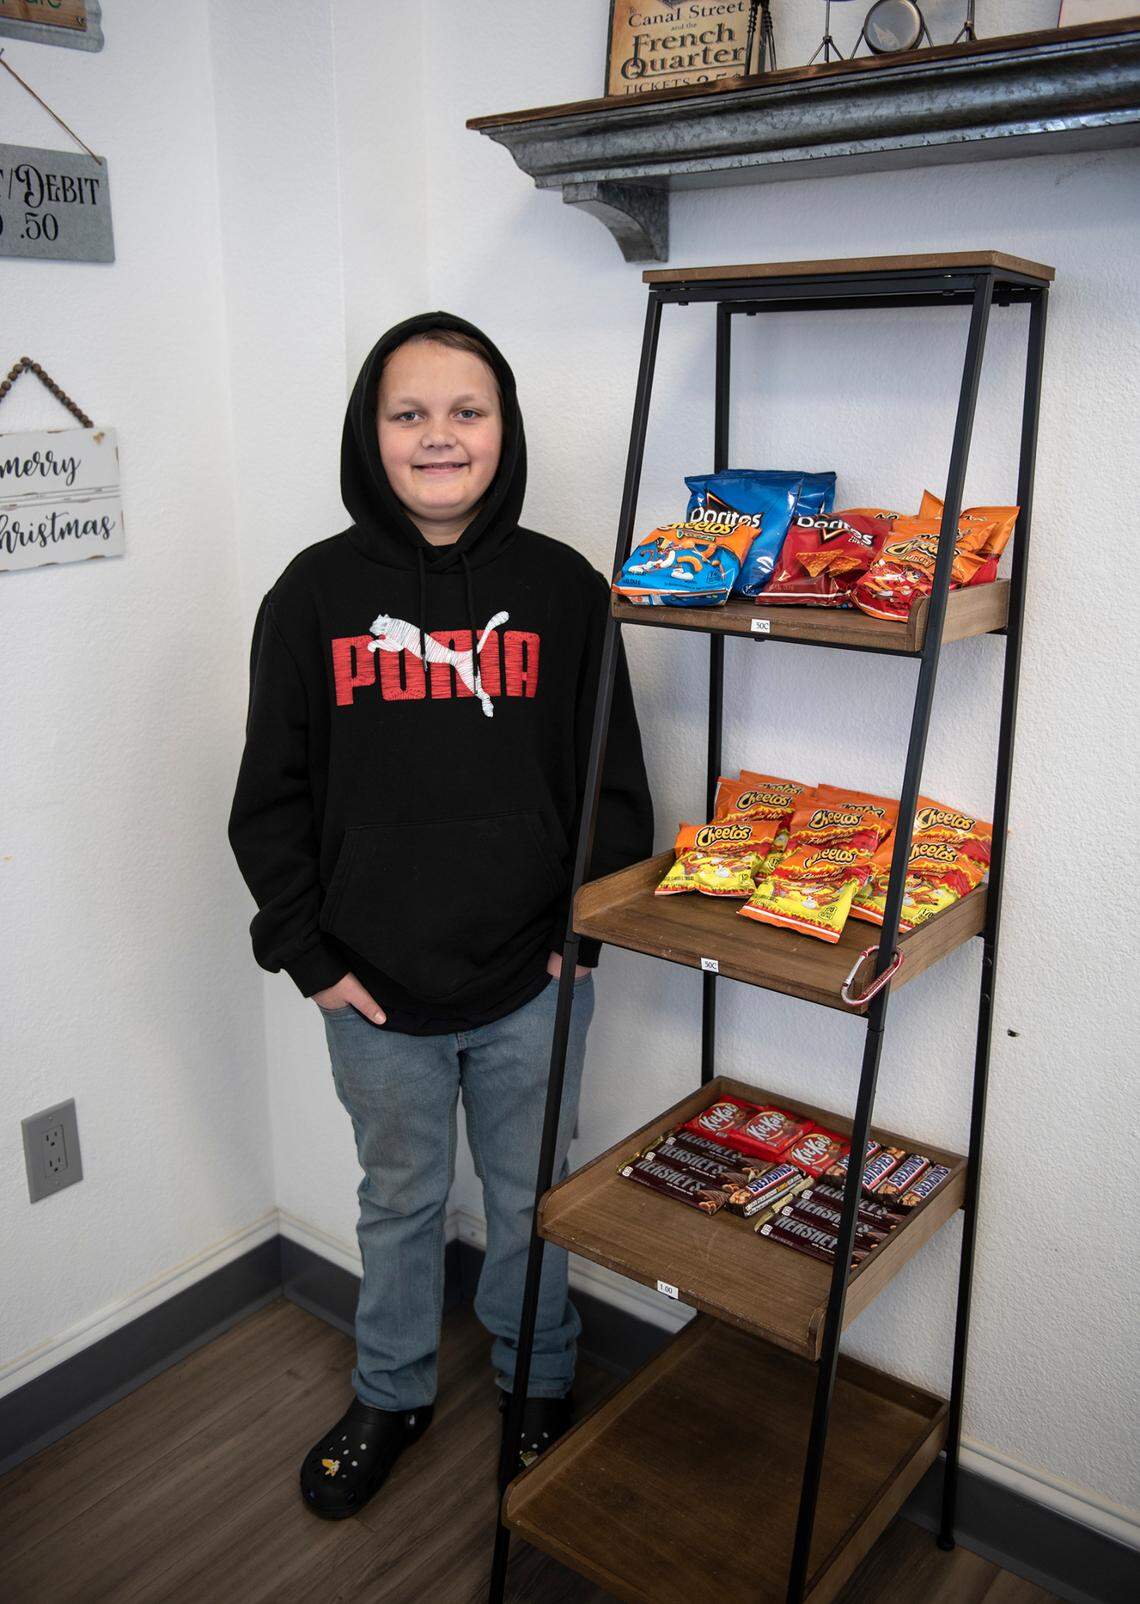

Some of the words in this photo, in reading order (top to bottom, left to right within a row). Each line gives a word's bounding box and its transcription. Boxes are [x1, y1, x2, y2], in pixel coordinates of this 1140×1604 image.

[628, 8, 681, 28] Canal
[689, 1, 745, 19] Street
[632, 22, 736, 52] French
[621, 46, 745, 80] Quarter
[21, 212, 59, 241] .50
[0, 450, 81, 486] merry
[0, 512, 116, 554] hristmas
[331, 629, 541, 706] PUMA
[737, 791, 792, 811] Cheetos
[808, 809, 863, 830] Cheetos
[917, 808, 976, 832] Cheetos
[696, 825, 752, 848] Cheetos
[908, 842, 958, 863] heetos
